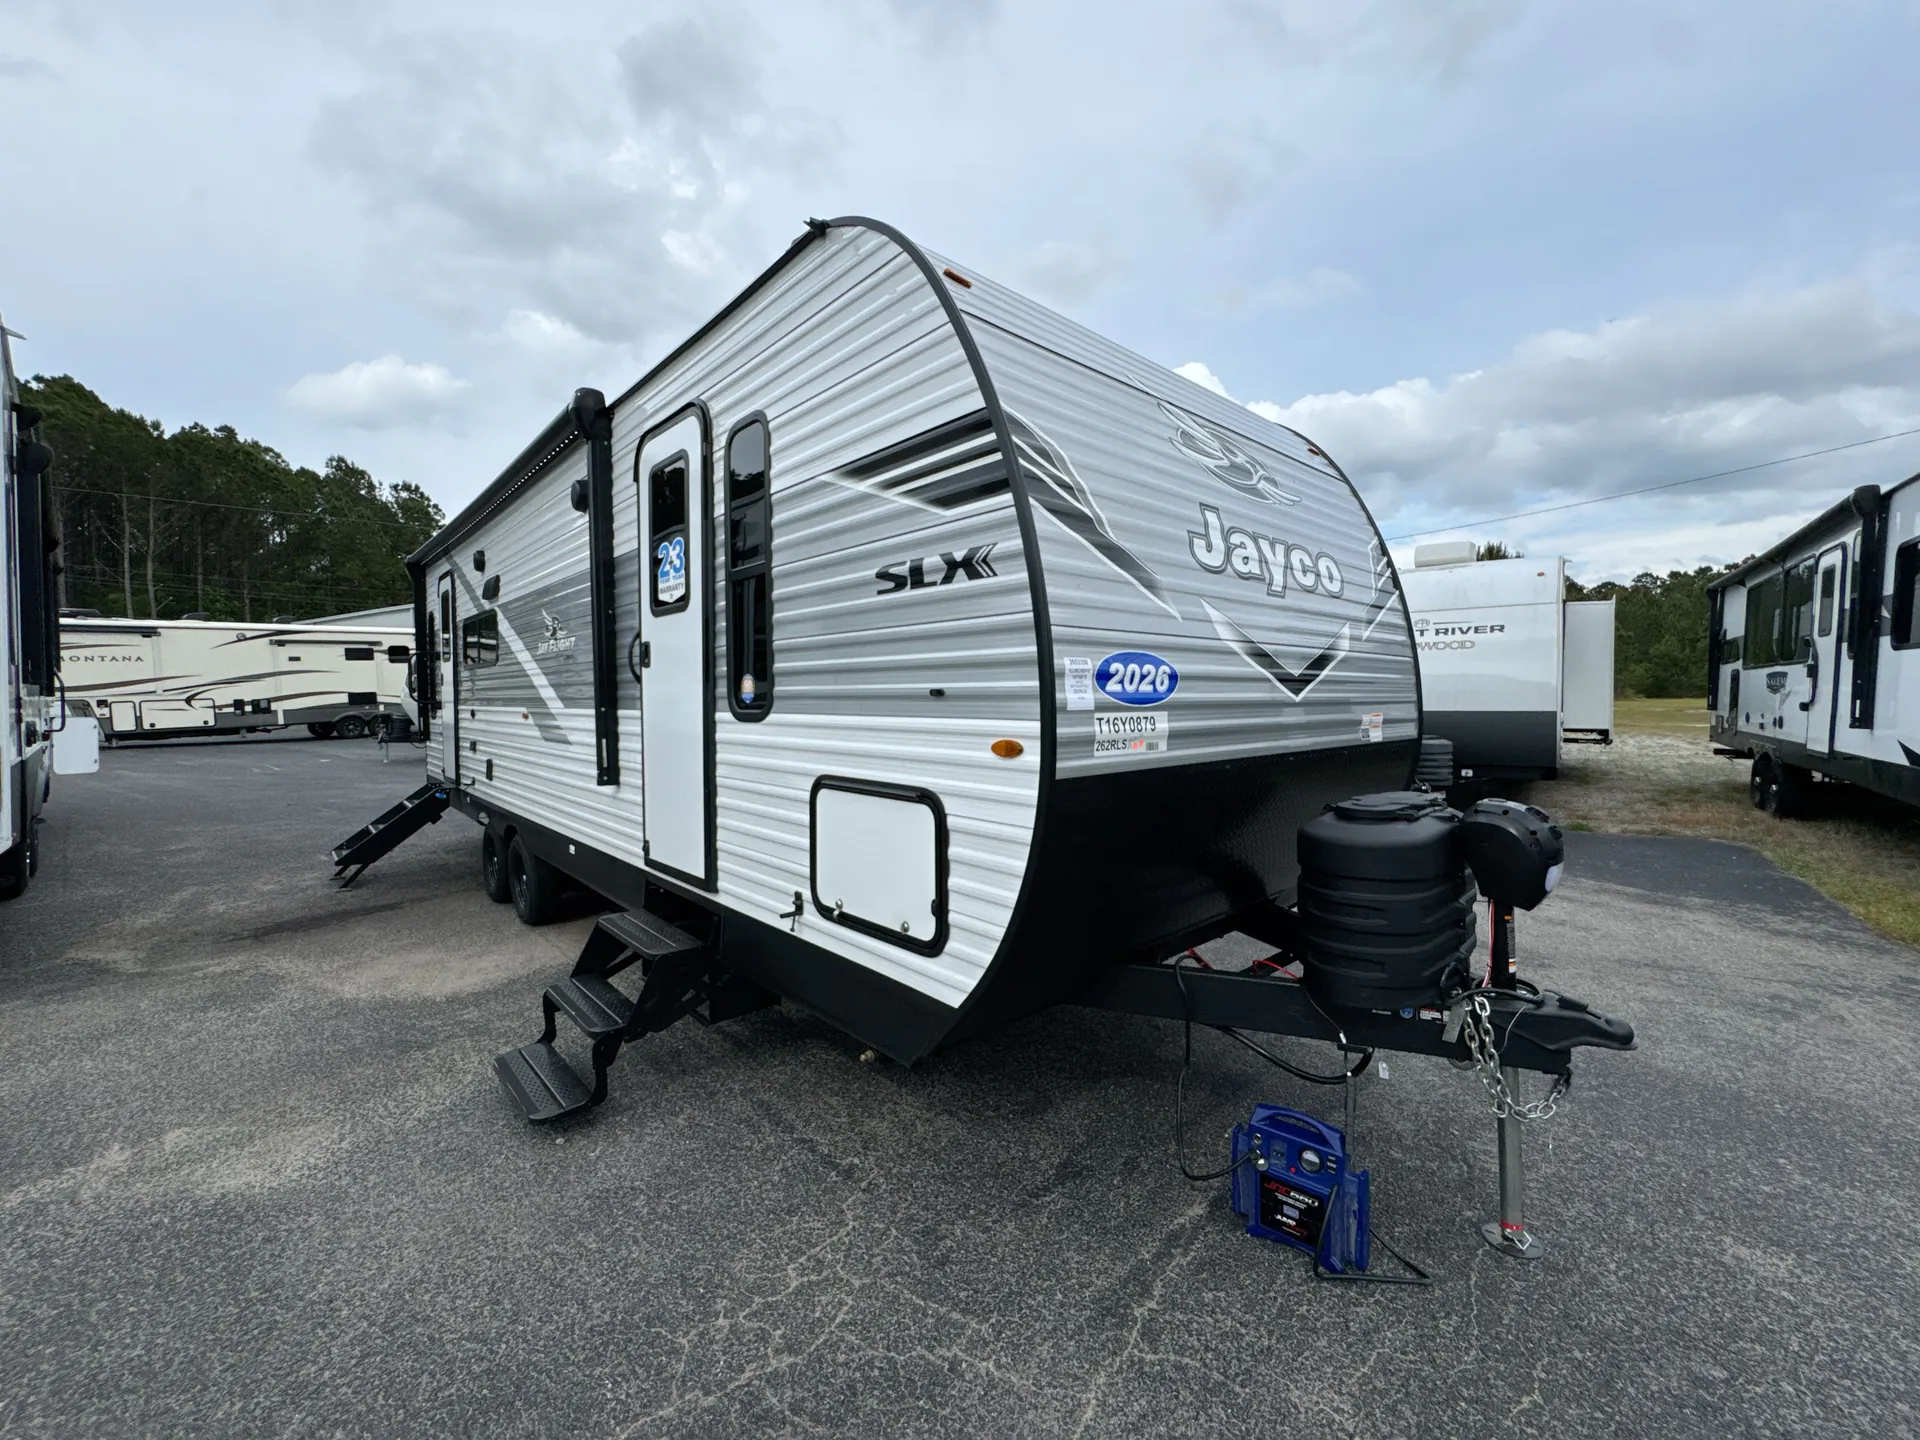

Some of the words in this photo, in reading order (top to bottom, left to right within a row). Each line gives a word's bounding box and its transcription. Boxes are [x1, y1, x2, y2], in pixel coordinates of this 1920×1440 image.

[1187, 501, 1344, 598] Jayco
[875, 542, 998, 595] SLX
[659, 583, 684, 594] WARRANTY
[1434, 624, 1505, 636] RIVER
[1416, 640, 1476, 651] WOOD
[1105, 662, 1171, 693] 2026
[1096, 716, 1156, 735] T16Y0879
[1096, 738, 1127, 752] 262RLS
